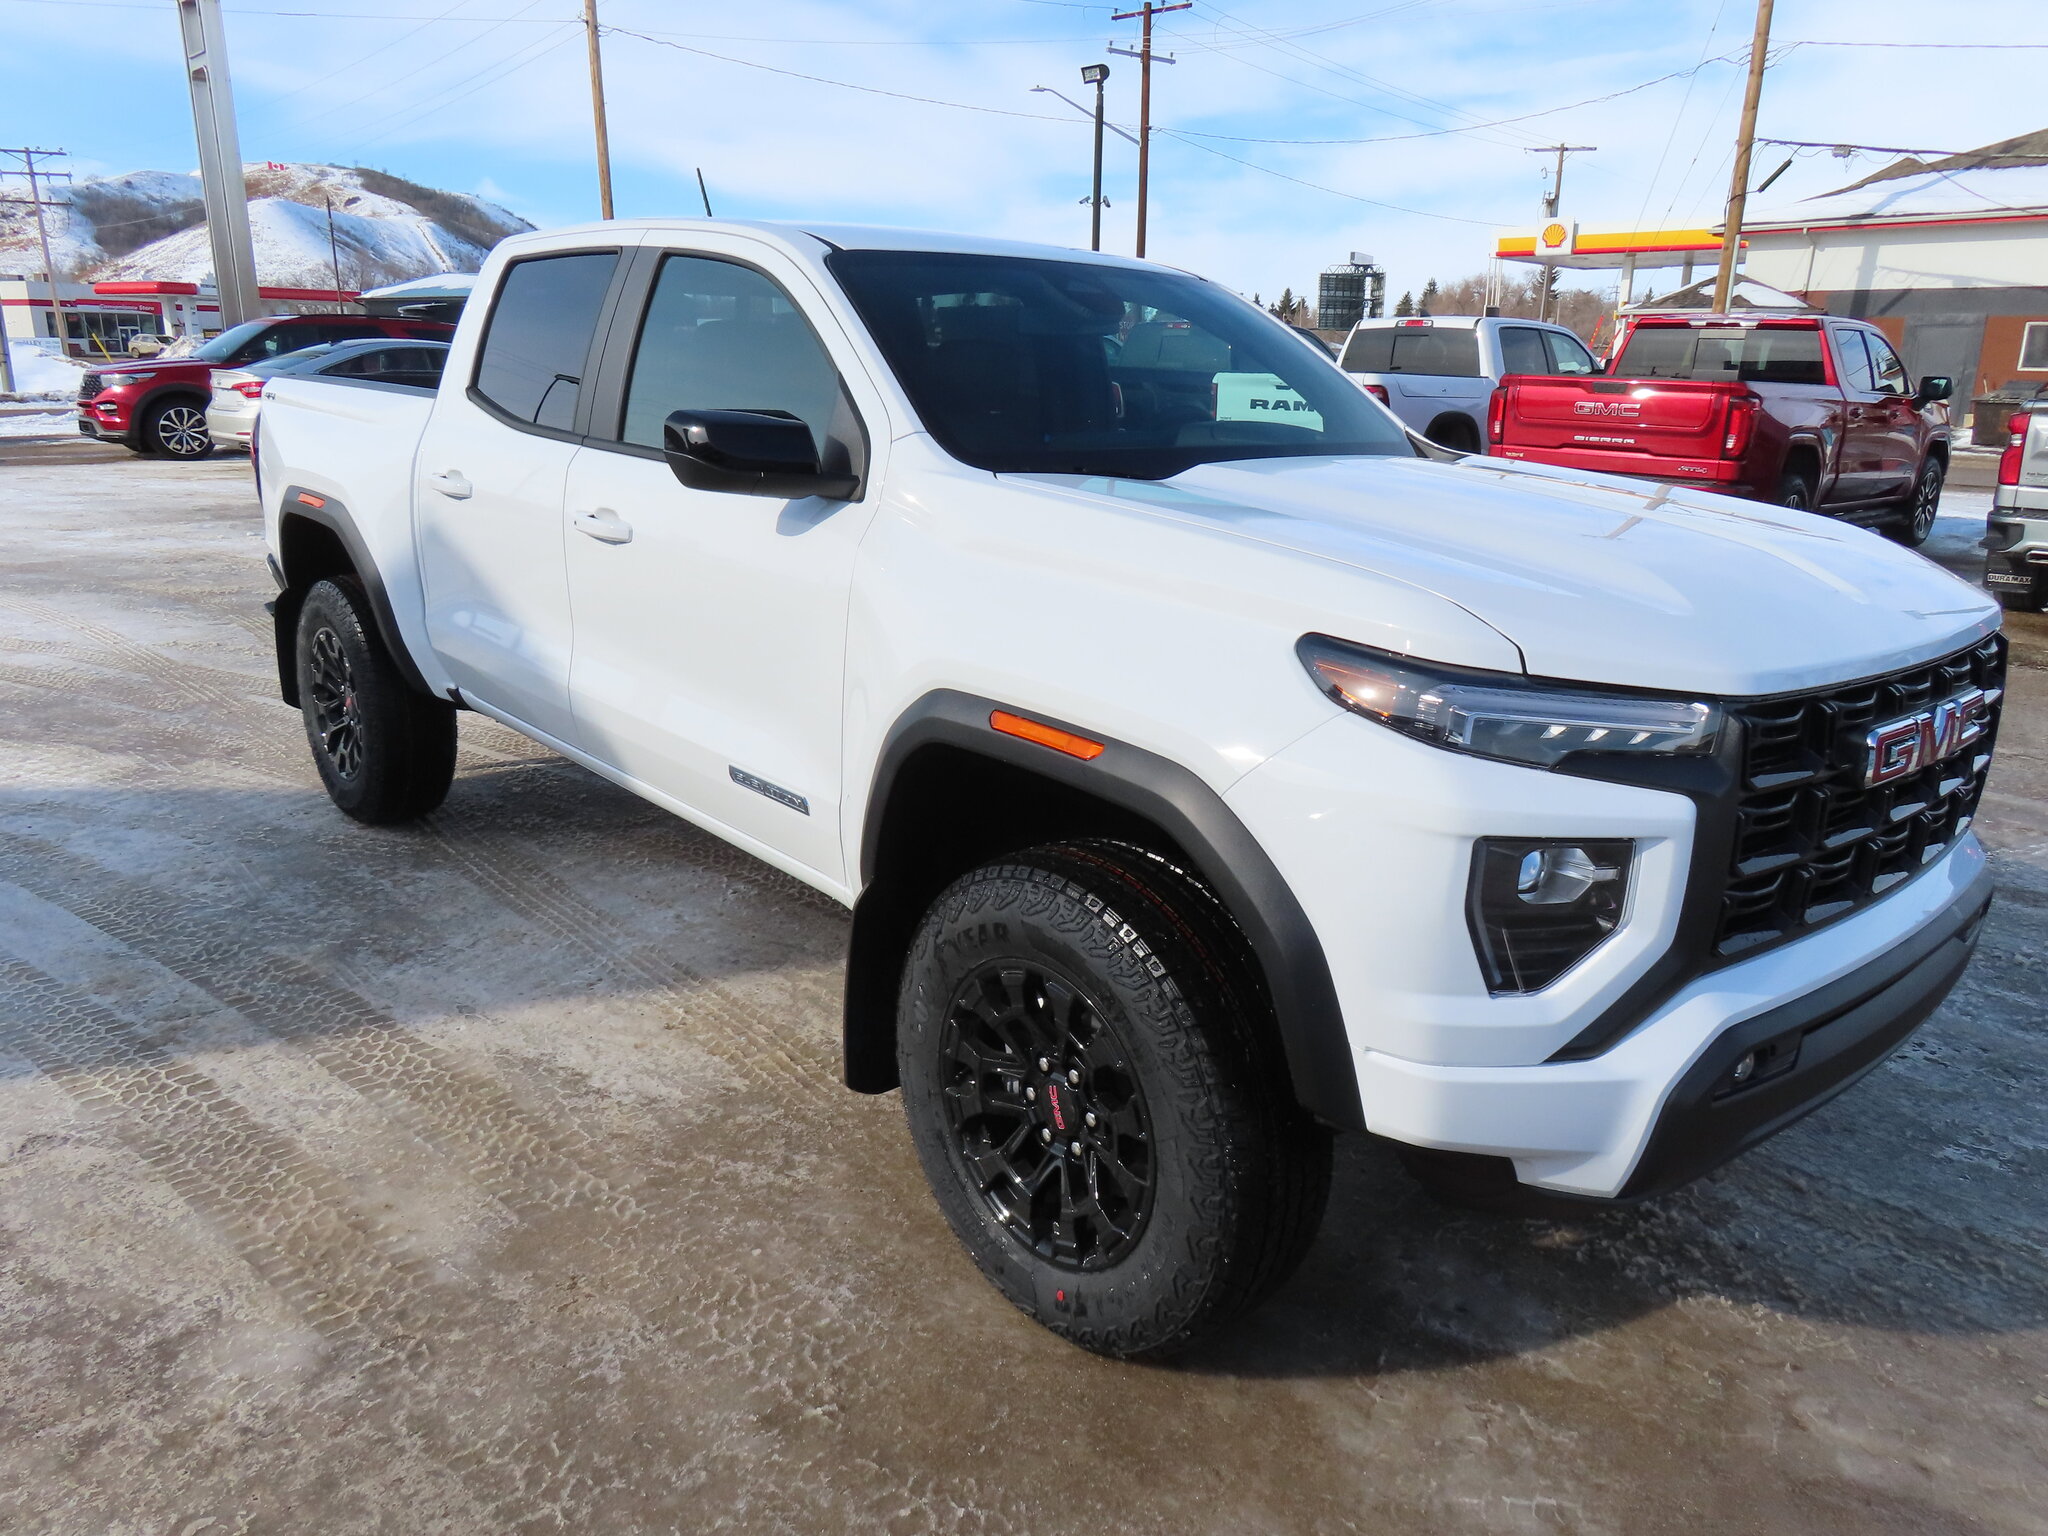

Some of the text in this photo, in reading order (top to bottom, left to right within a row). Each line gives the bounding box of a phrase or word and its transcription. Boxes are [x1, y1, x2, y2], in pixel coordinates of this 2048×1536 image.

[1249, 398, 1315, 412] RAM
[1573, 401, 1641, 417] GMC
[1573, 435, 1635, 444] SIERRA
[1988, 574, 2032, 584] DURAMAX
[1865, 688, 1985, 789] GMC
[1049, 1085, 1066, 1130] GMC
